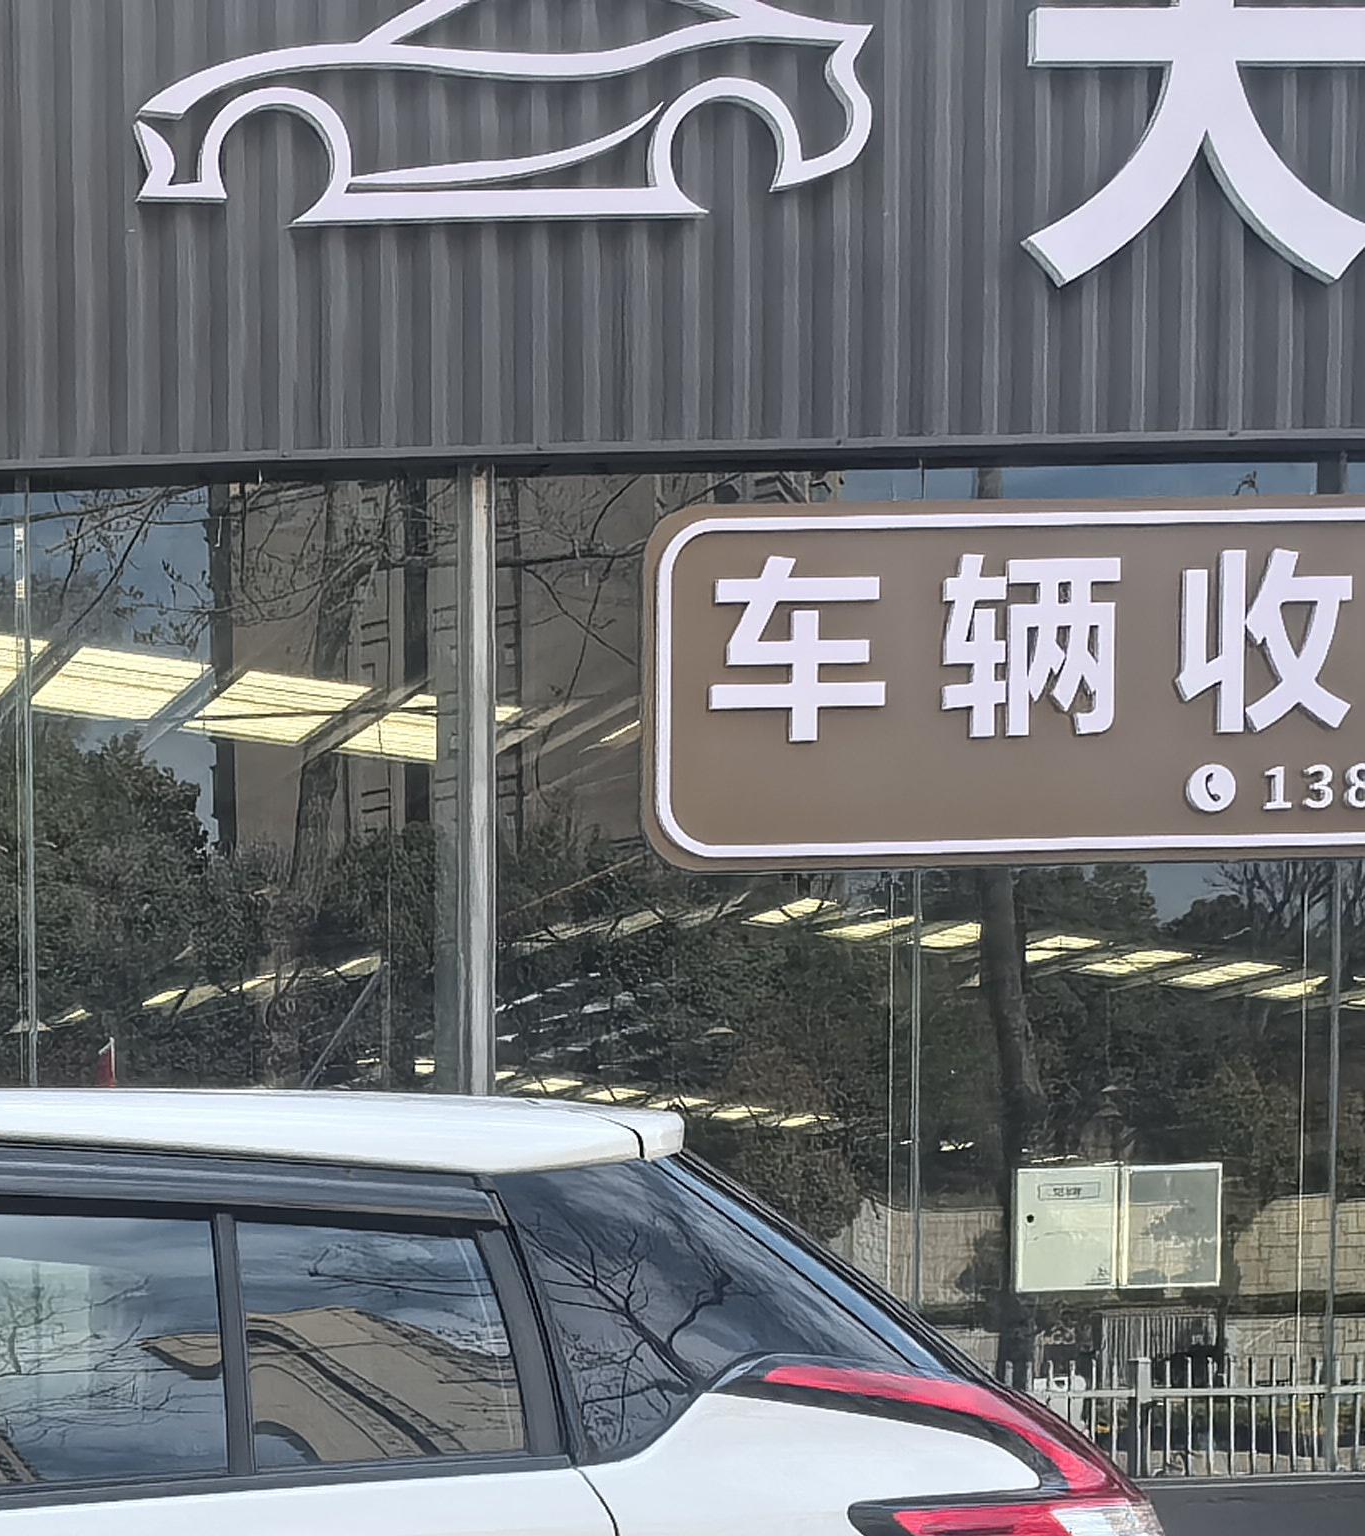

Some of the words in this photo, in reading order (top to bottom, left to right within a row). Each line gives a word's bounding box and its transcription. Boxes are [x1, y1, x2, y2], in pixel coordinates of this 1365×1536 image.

[709, 547, 1354, 743] 车辆收
[1263, 762, 1365, 810] 138
